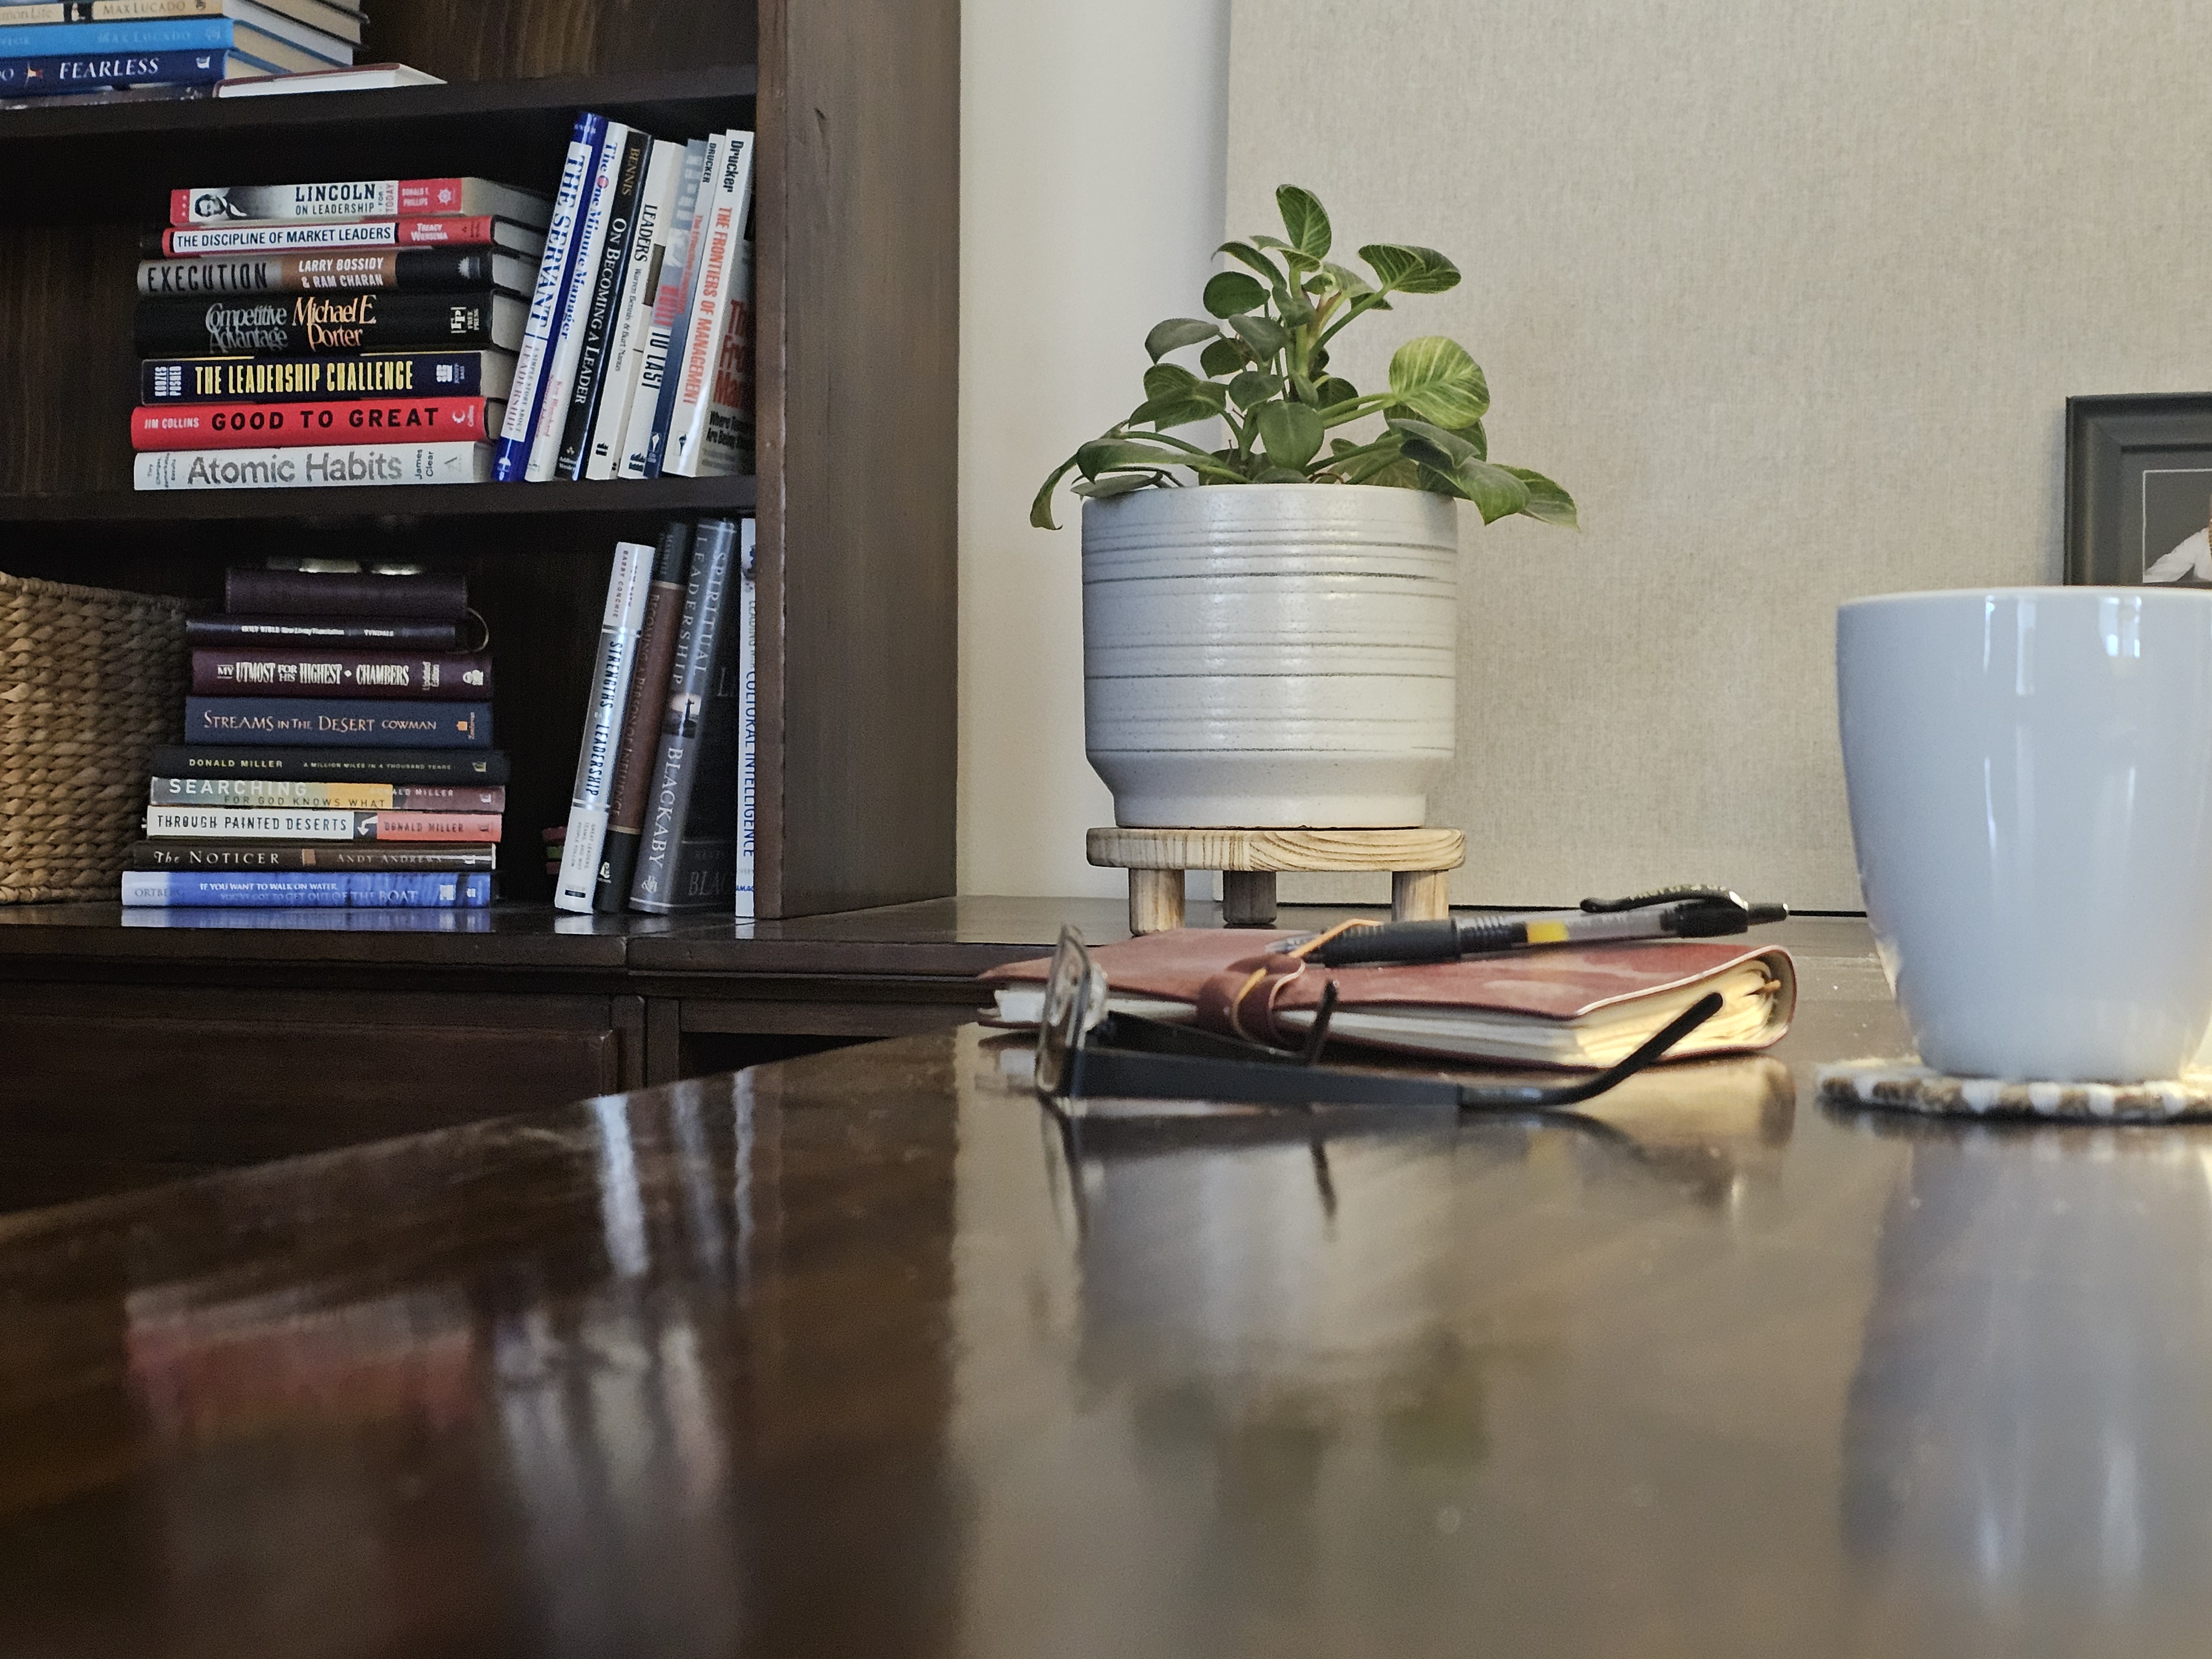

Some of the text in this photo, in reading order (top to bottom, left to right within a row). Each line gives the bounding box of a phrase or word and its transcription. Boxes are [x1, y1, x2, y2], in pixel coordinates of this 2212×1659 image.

[102, 1, 186, 15] MAX LUCADO
[59, 57, 160, 81] FEARLESS
[622, 148, 641, 196] BENNIS
[702, 142, 717, 184] DRUCKER
[722, 139, 745, 194] Drucker
[295, 183, 376, 202] LINCOLN
[385, 183, 394, 213] TODAY
[295, 202, 375, 215] ON LEADERSHIP
[715, 207, 733, 229] THE
[177, 227, 391, 248] THE DISCIPLINE OF MARKET LEADERS
[529, 154, 586, 328] THE SERVANT
[560, 142, 618, 340] The One Minute Manager
[634, 203, 659, 262] LEADERS
[148, 262, 268, 292] EXECUTION
[298, 257, 384, 273] LARRY BOSSIDY
[703, 231, 728, 298] FRONTIERS
[301, 274, 384, 288] & RAM CHARAN
[632, 268, 642, 294] Warren
[205, 302, 288, 333] Competitive
[291, 296, 358, 327] Michael
[574, 218, 628, 405] ON BECOMING A LEADER
[625, 295, 637, 321] Bennis
[700, 300, 716, 316] OF
[209, 326, 289, 354] Advantage
[307, 322, 364, 353] Porter
[620, 330, 630, 347] Burt
[527, 353, 539, 377] SIMPLE
[615, 349, 627, 372] Nanus
[682, 317, 713, 405] MANAGEMENT
[195, 360, 413, 395] THE LEADERSHIP CHALLENGE
[505, 344, 533, 432] LEADERSHIP
[521, 380, 532, 405] STORY
[144, 417, 200, 430] JIM COLLINS
[212, 407, 439, 431] GOOD TO GREAT
[187, 450, 403, 484] Atomic Habits
[415, 448, 423, 480] James
[425, 451, 434, 478] Clear
[612, 550, 629, 619] BARRY CONCHIE
[672, 536, 708, 686] LEADERSHIP
[694, 552, 727, 677] SPIRITUAL
[217, 662, 276, 684] MY UTMOST
[278, 664, 298, 674] FOR
[279, 673, 296, 682] HIS
[299, 664, 410, 686] HIGHEST CHAMBERS
[600, 640, 623, 709] STRENGTHS
[204, 709, 437, 733] STREAMS IN THE DESERT COWMAN
[745, 671, 756, 747] CULTURAL
[189, 758, 236, 768] DONALD
[240, 759, 283, 768] MILLER
[585, 724, 611, 796] LEADERSHIP
[168, 778, 308, 796] SEARCHING
[413, 788, 454, 797] MILLER
[223, 796, 386, 808] FOR GOD KNOWS WHAT
[648, 746, 685, 869] BLACKABY
[743, 753, 756, 857] INTELLIGENCE
[157, 814, 347, 832] THROUGH PAINTED DESERTS
[384, 821, 463, 832] DONALD MILLER
[153, 850, 180, 864] The
[189, 850, 280, 865] NOTICER
[336, 853, 373, 864] ANDY
[199, 883, 337, 891] IF YOU WANT TO WALK ON WATER
[285, 891, 307, 901] GET
[309, 891, 330, 901] OUT
[331, 891, 348, 901] OF
[350, 891, 377, 901] THE
[379, 889, 418, 902] BOAT
